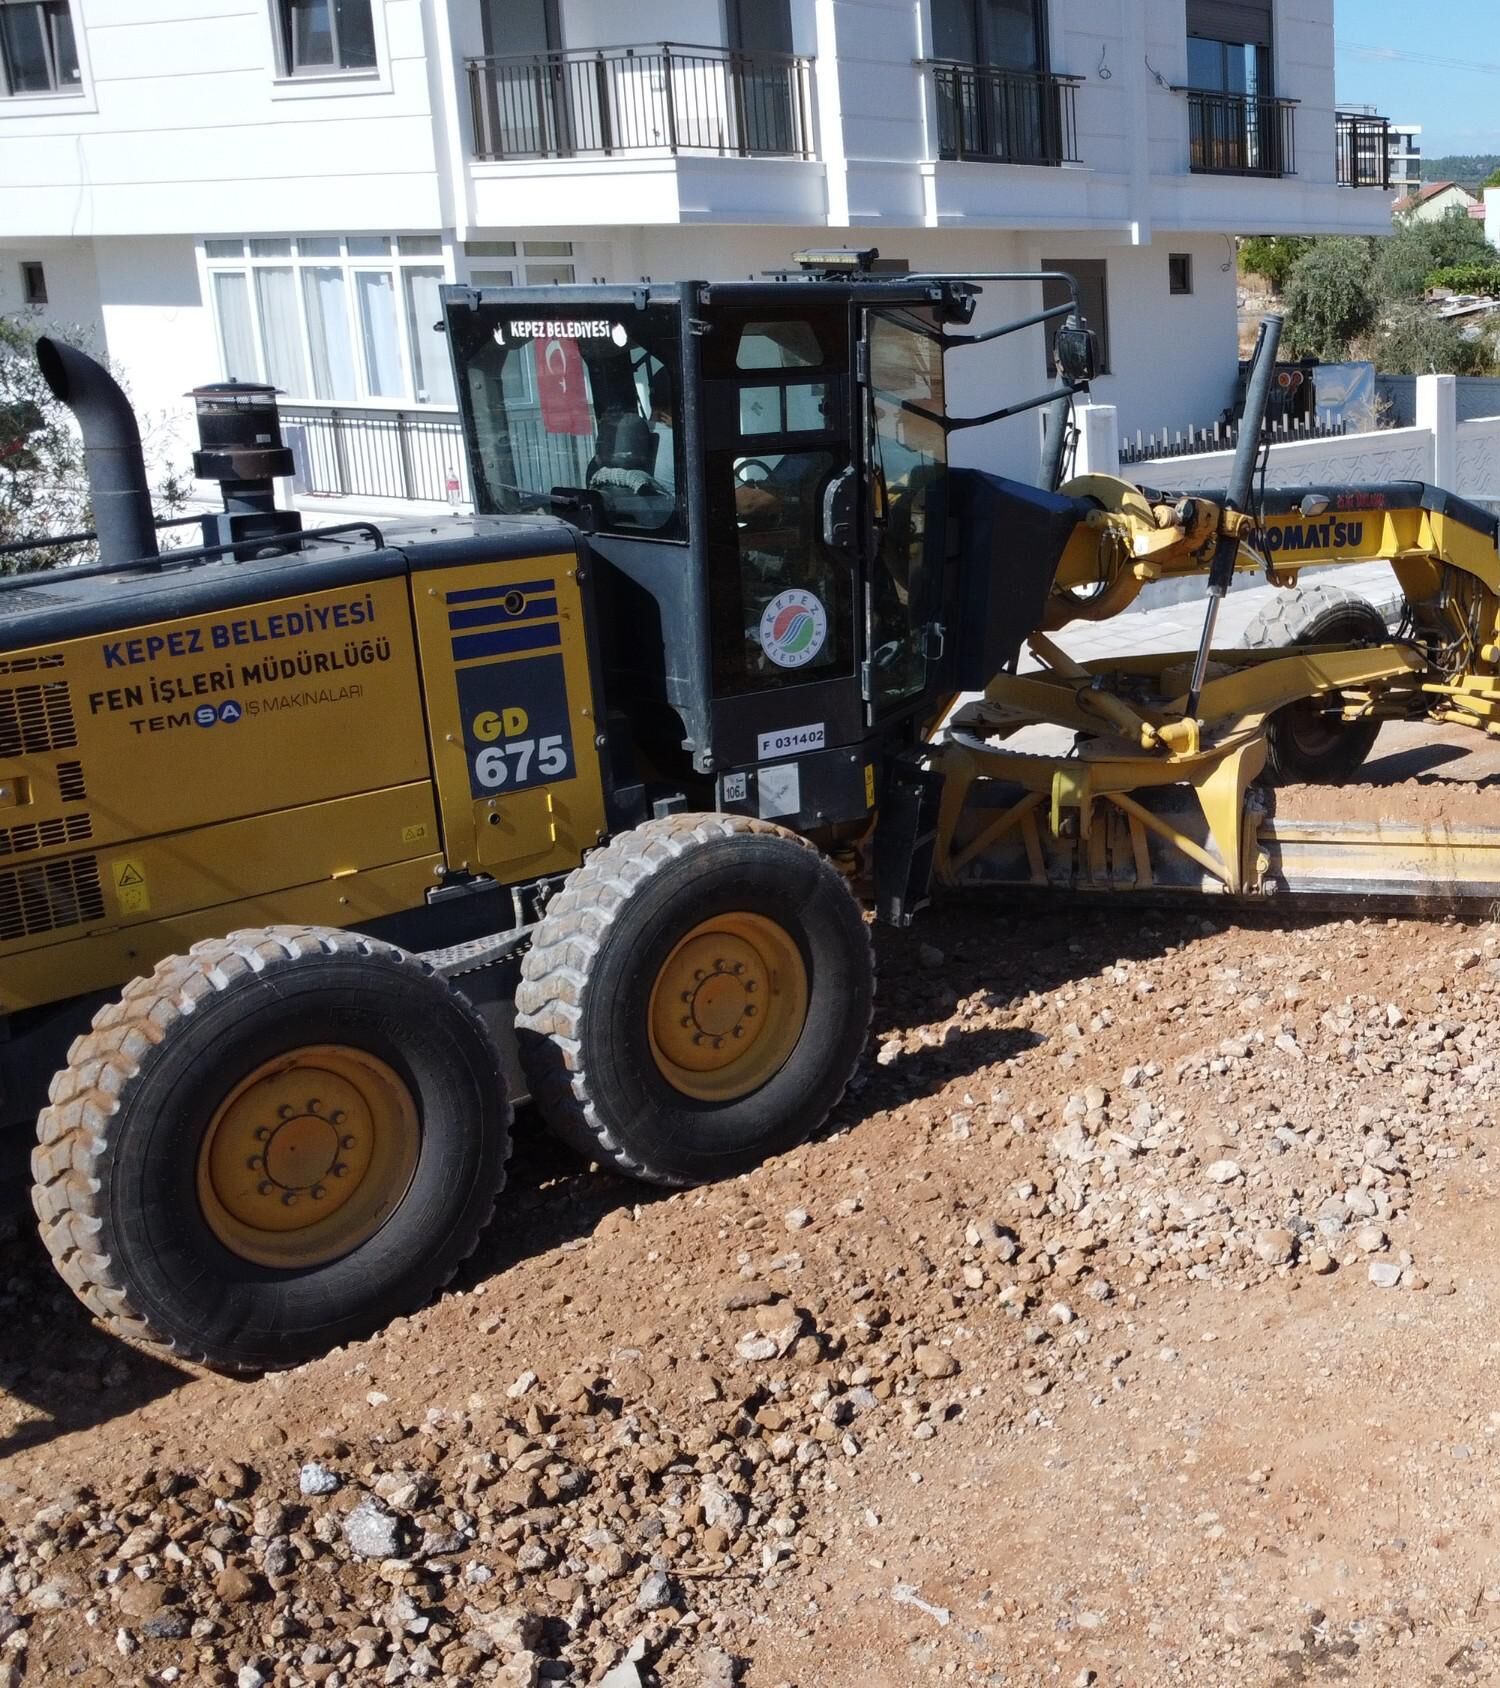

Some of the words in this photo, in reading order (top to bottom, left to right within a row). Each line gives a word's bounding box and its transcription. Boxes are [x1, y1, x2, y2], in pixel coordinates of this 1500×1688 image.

[511, 320, 545, 338] KEPEZ
[766, 594, 819, 623] KEPEZ
[103, 629, 204, 669] KEPEZ
[211, 593, 374, 649] BELEDİYESİ
[89, 685, 144, 715] FEN
[150, 663, 235, 703] İŞLERİ
[241, 636, 391, 686] MÜDÜRLÜĞÜ
[130, 701, 241, 734] TEMSA
[473, 707, 528, 742] GD
[763, 741, 770, 751] F
[775, 730, 824, 749] 031402
[475, 734, 568, 788] 675
